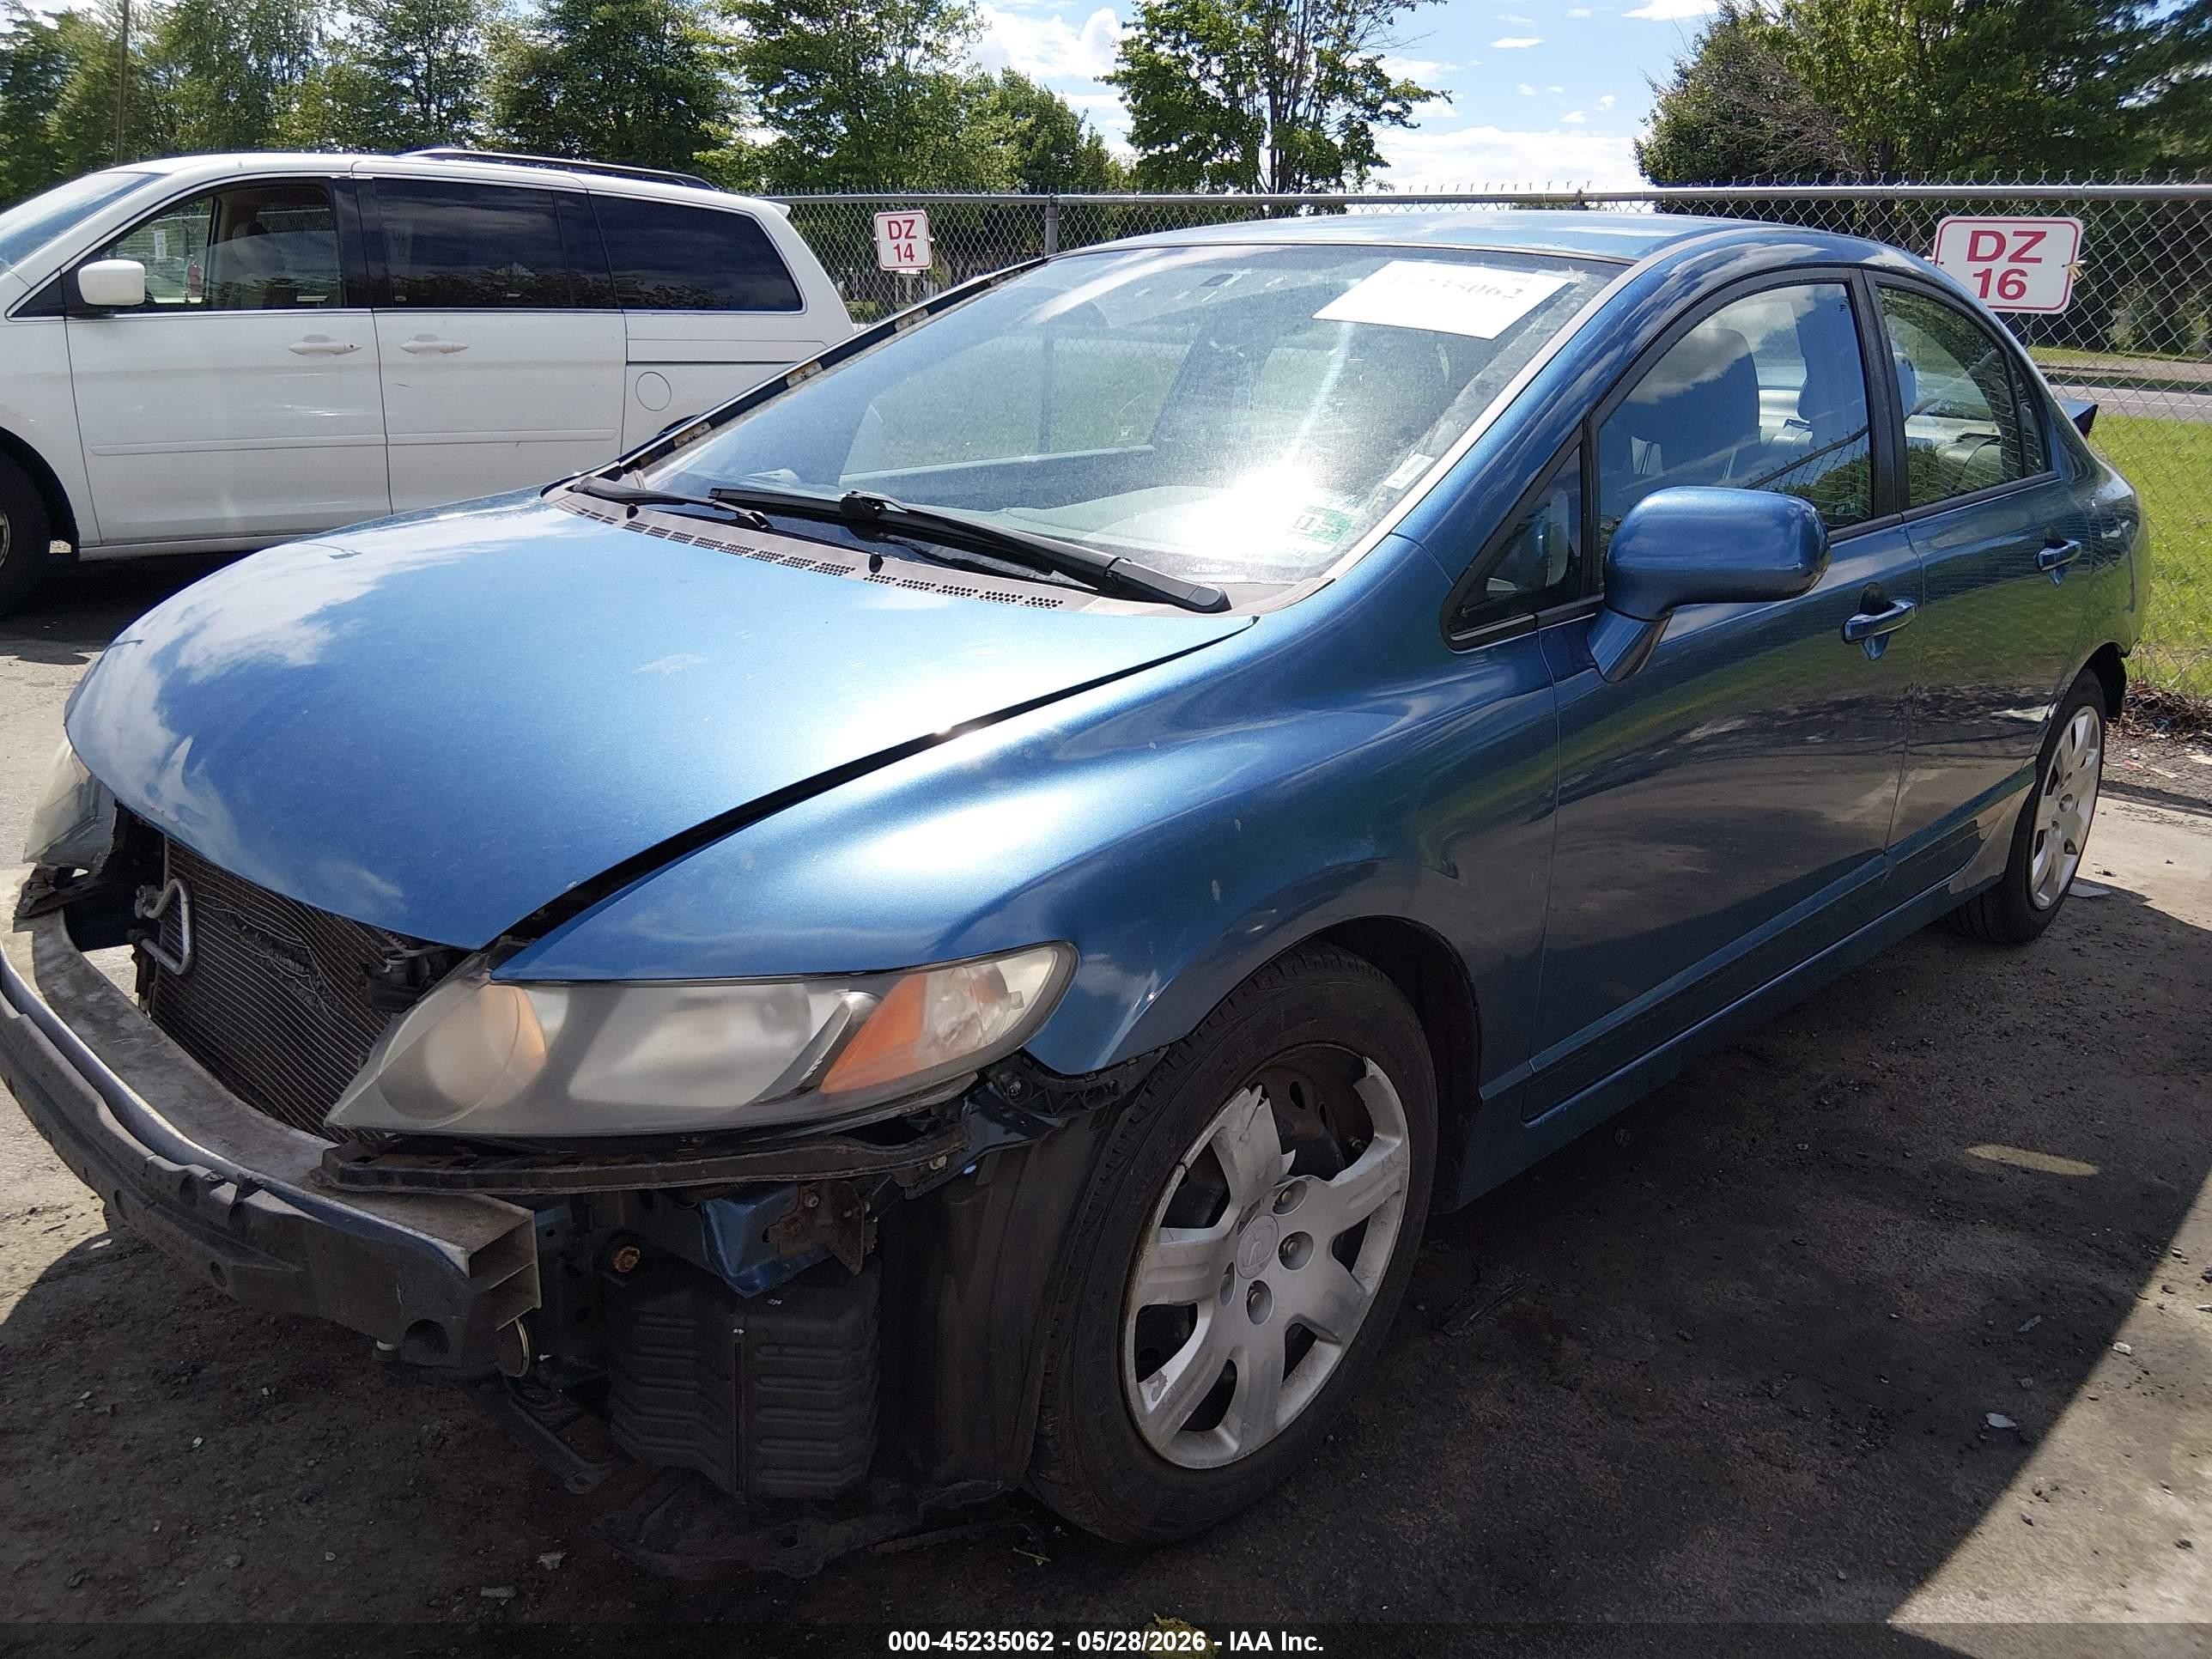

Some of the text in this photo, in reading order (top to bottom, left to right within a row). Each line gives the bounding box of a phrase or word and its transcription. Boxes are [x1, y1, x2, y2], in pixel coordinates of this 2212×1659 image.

[887, 219, 917, 240] DZ
[893, 242, 915, 263] 14
[1966, 230, 2047, 264] DZ
[1972, 268, 2028, 301] 16
